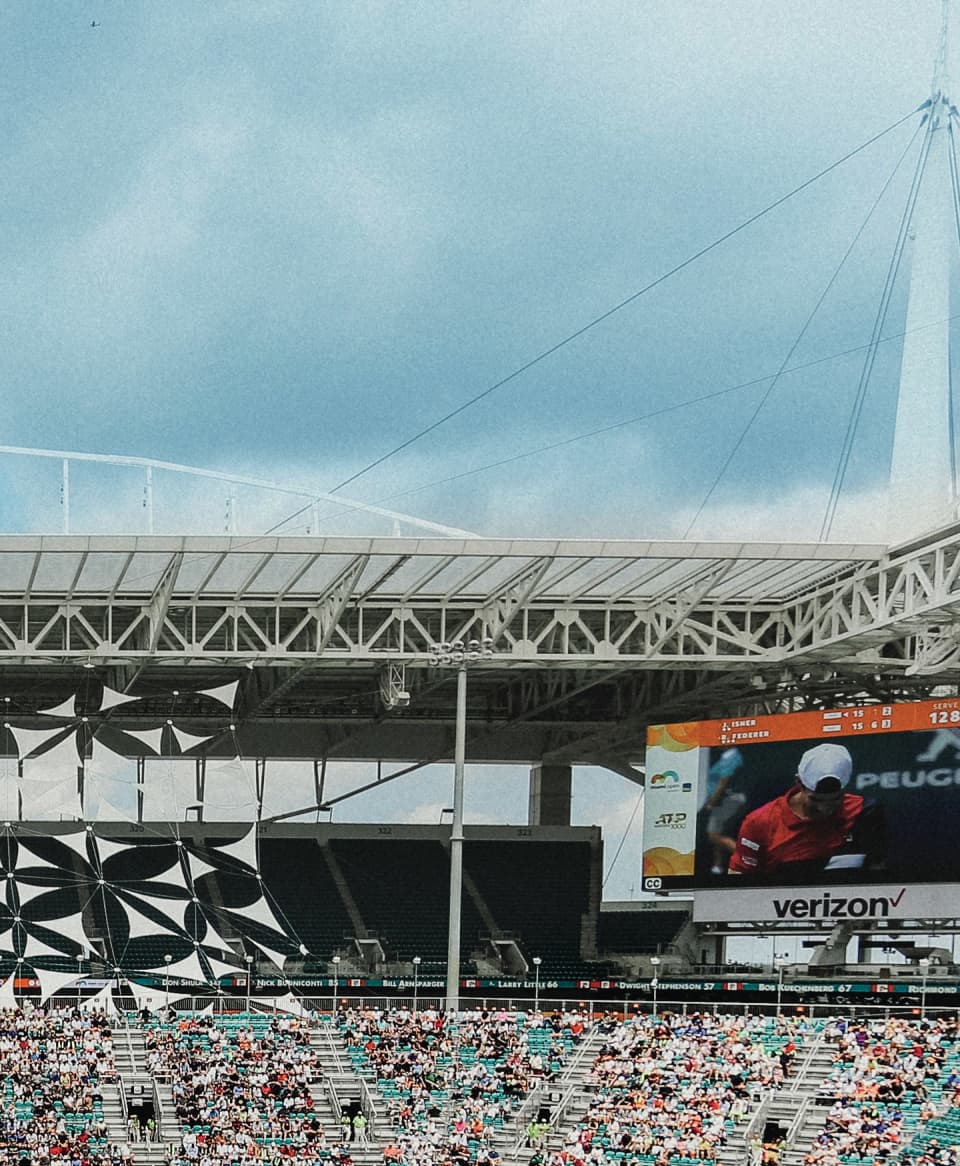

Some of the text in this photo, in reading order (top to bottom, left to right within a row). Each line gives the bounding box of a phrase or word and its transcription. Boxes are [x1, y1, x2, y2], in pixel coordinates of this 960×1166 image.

[933, 702, 958, 710] SERVE
[929, 710, 960, 724] 128
[732, 731, 769, 739] FEDERER
[655, 813, 687, 824] ATP
[646, 879, 660, 888] CC
[773, 893, 889, 918] verizon
[703, 983, 715, 991] 57
